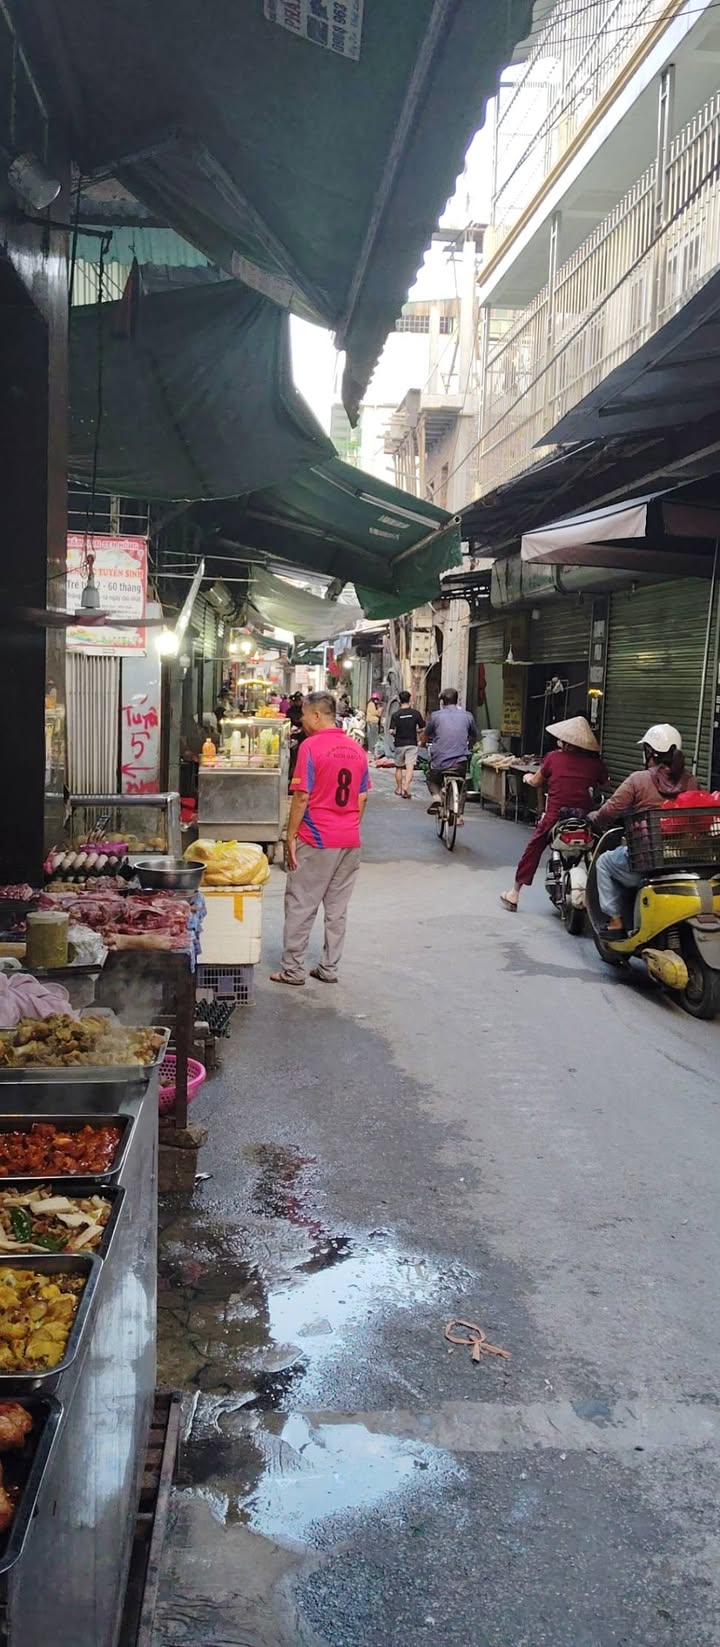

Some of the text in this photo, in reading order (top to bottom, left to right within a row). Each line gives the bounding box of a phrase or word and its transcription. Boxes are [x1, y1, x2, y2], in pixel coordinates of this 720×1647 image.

[107, 582, 117, 591] 60
[130, 731, 151, 760] 5
[335, 768, 352, 807] 8
